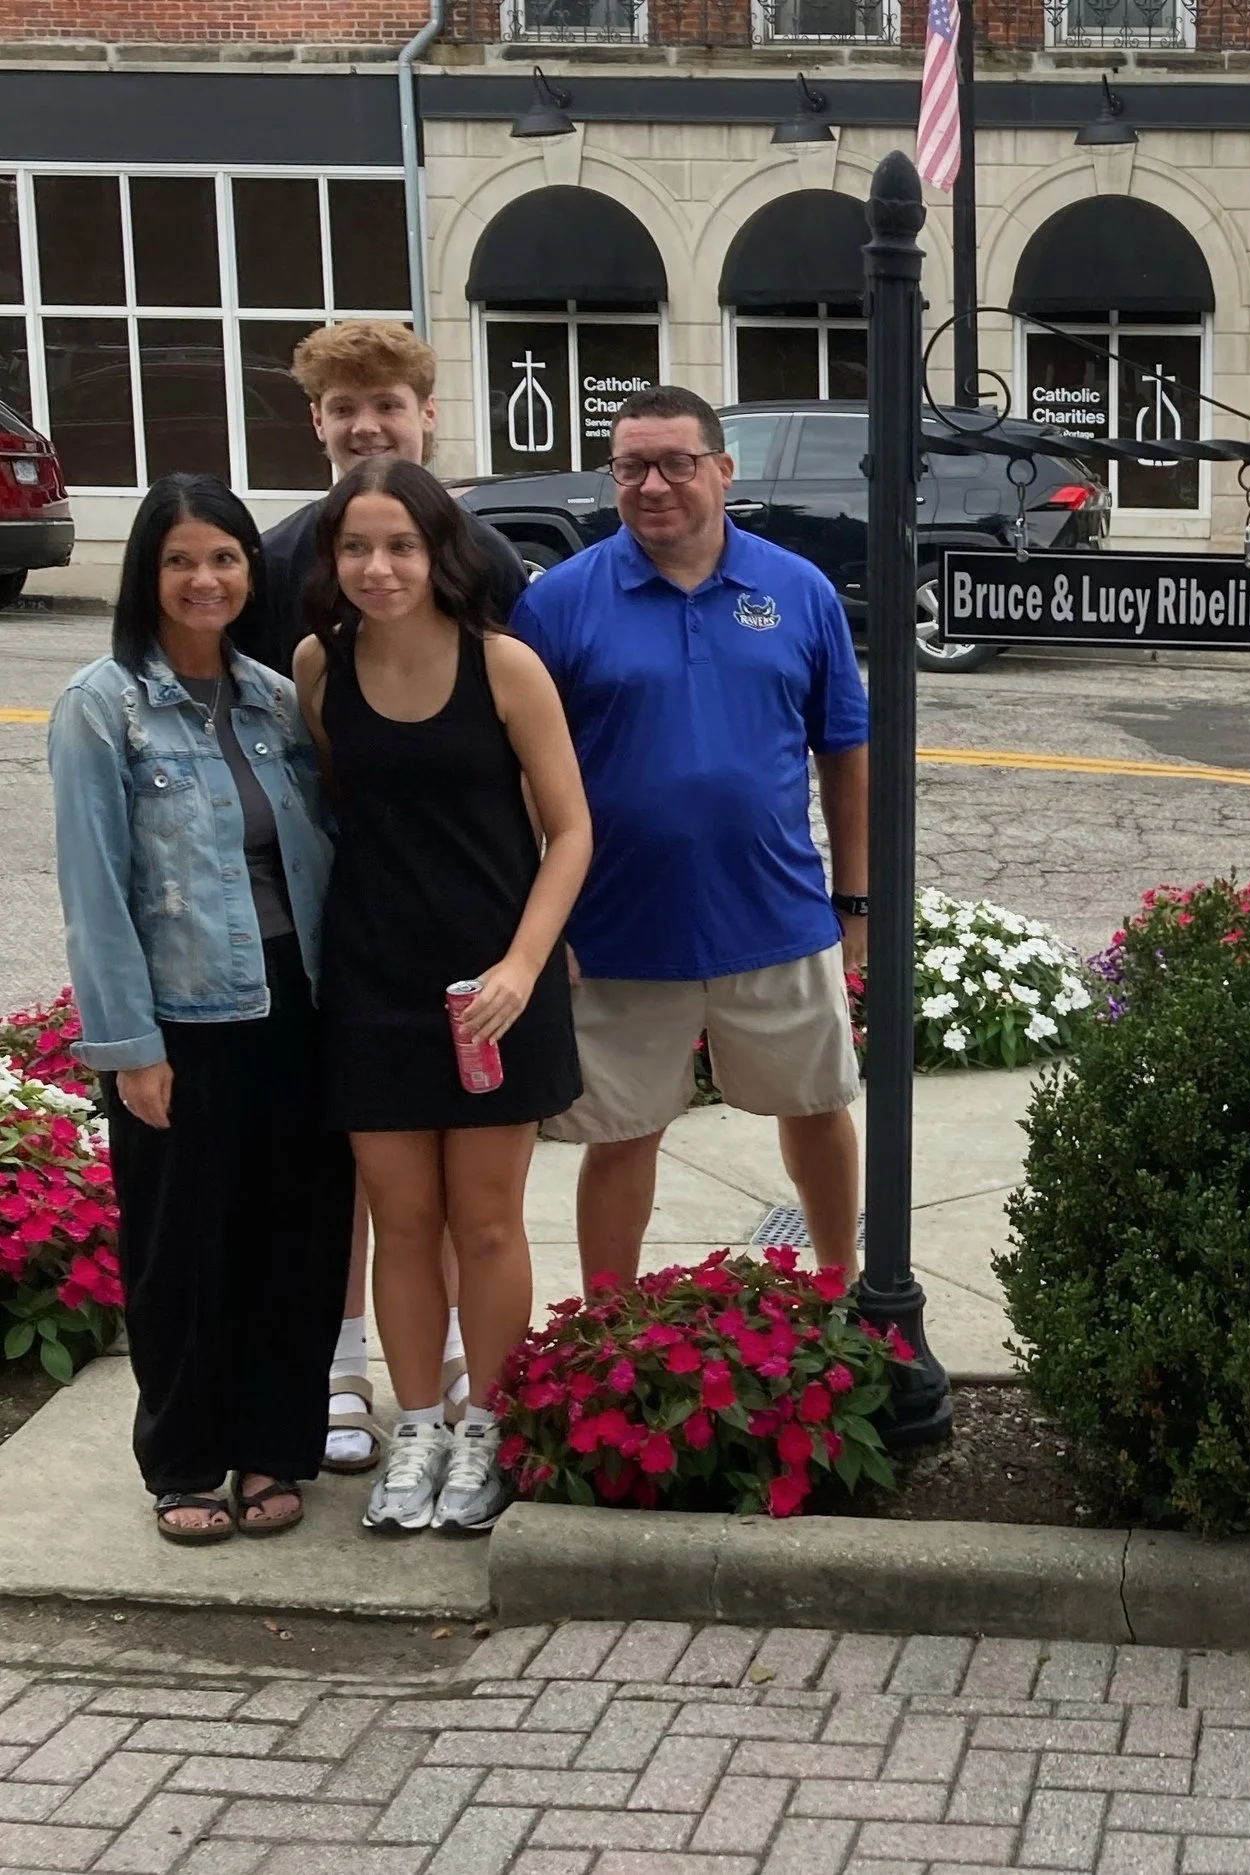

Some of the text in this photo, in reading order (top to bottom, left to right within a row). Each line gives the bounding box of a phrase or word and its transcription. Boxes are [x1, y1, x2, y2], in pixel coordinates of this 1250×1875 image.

[583, 376, 651, 391] Catholic
[1032, 386, 1100, 403] Catholic
[1032, 408, 1106, 424] Charities
[953, 571, 1043, 621] Bruce
[1051, 574, 1074, 621] &
[1082, 575, 1150, 634] Lucy
[740, 614, 775, 626] RAVENS
